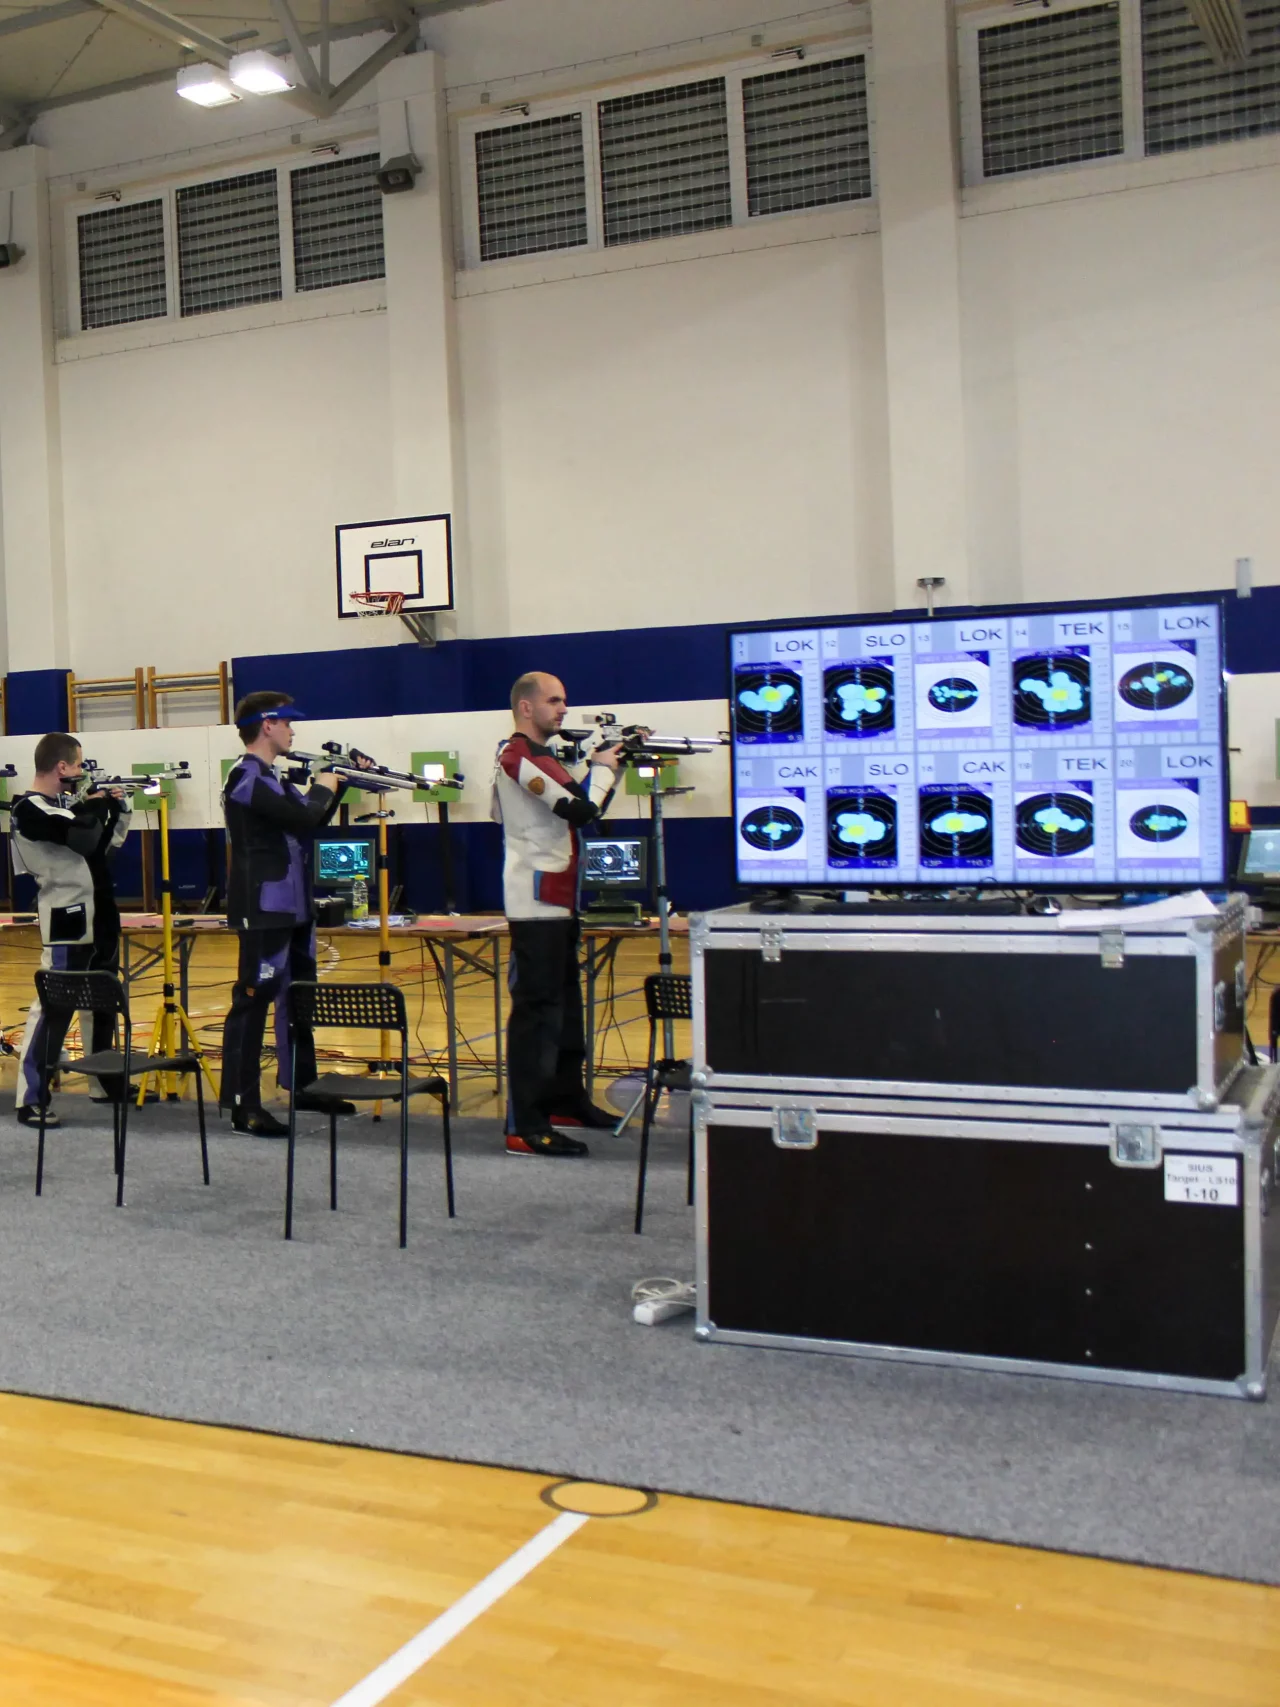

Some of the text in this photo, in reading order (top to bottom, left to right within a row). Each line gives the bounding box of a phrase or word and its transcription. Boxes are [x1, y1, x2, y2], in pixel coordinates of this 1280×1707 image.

[370, 538, 415, 548] elan
[1058, 622, 1104, 636] TEK
[1164, 616, 1211, 630] LOK
[865, 634, 906, 648] SLO
[960, 629, 1002, 642] LOK
[774, 640, 814, 652] LOK
[962, 761, 1006, 773] CAK
[1062, 757, 1108, 770] TEK
[1166, 755, 1214, 769] LOK
[778, 766, 818, 779] CAK
[868, 763, 909, 776] SLO
[1184, 1187, 1219, 1202] 1-10
